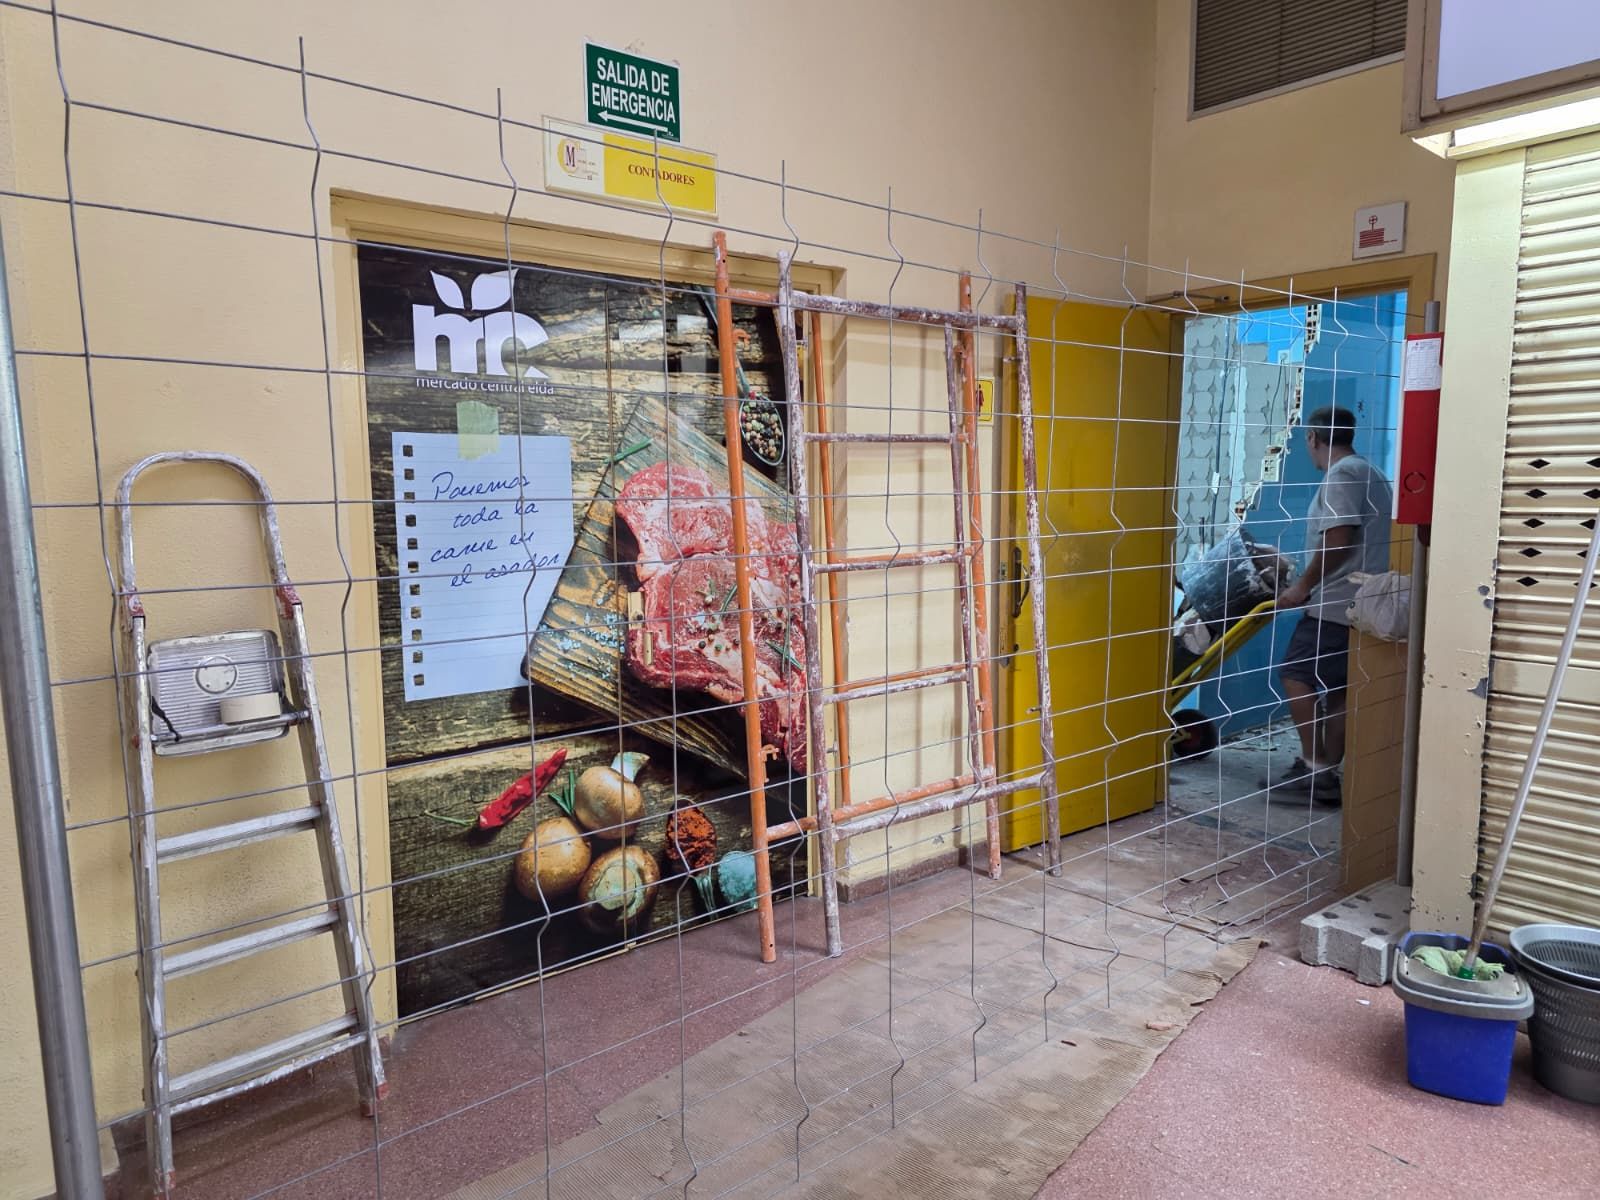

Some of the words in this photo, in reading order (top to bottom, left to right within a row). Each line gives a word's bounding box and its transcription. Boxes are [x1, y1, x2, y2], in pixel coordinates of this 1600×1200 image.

[597, 57, 648, 91] SALIDA
[652, 70, 670, 96] DE
[592, 82, 676, 123] EMERGENCIA
[628, 164, 695, 186] CONTADORES
[416, 376, 477, 390] mercado
[480, 380, 525, 393] central
[528, 381, 554, 395] elda
[432, 471, 530, 500] Ponemos
[453, 505, 503, 529] toda
[515, 497, 539, 516] la
[430, 540, 497, 563] carne
[510, 531, 534, 544] en
[451, 564, 473, 588] el
[485, 553, 560, 578] asador
